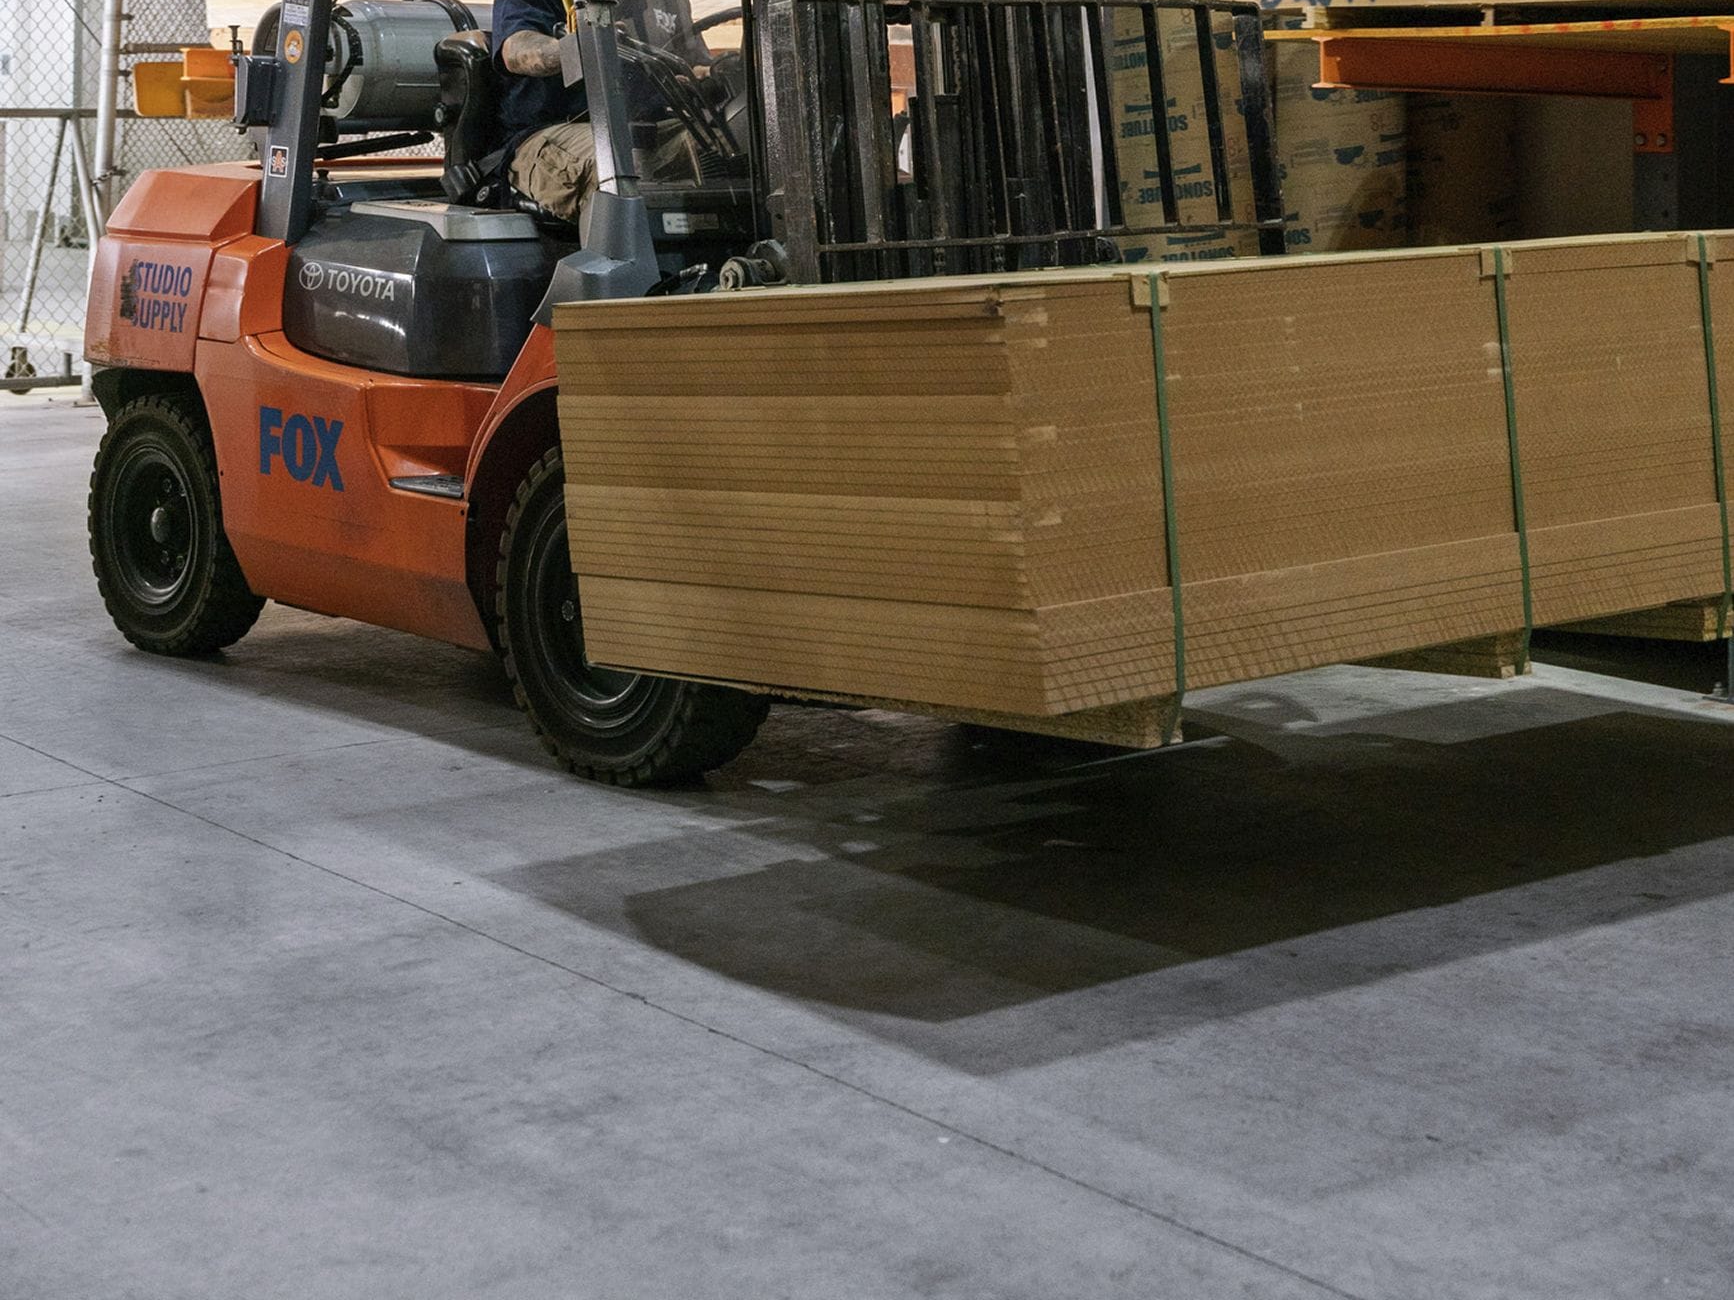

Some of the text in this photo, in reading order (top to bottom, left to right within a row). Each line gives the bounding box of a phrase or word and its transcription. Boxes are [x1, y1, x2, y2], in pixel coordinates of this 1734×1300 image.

[134, 261, 193, 298] STUDIO
[327, 268, 395, 302] TOYOTA
[260, 406, 345, 492] FOX
